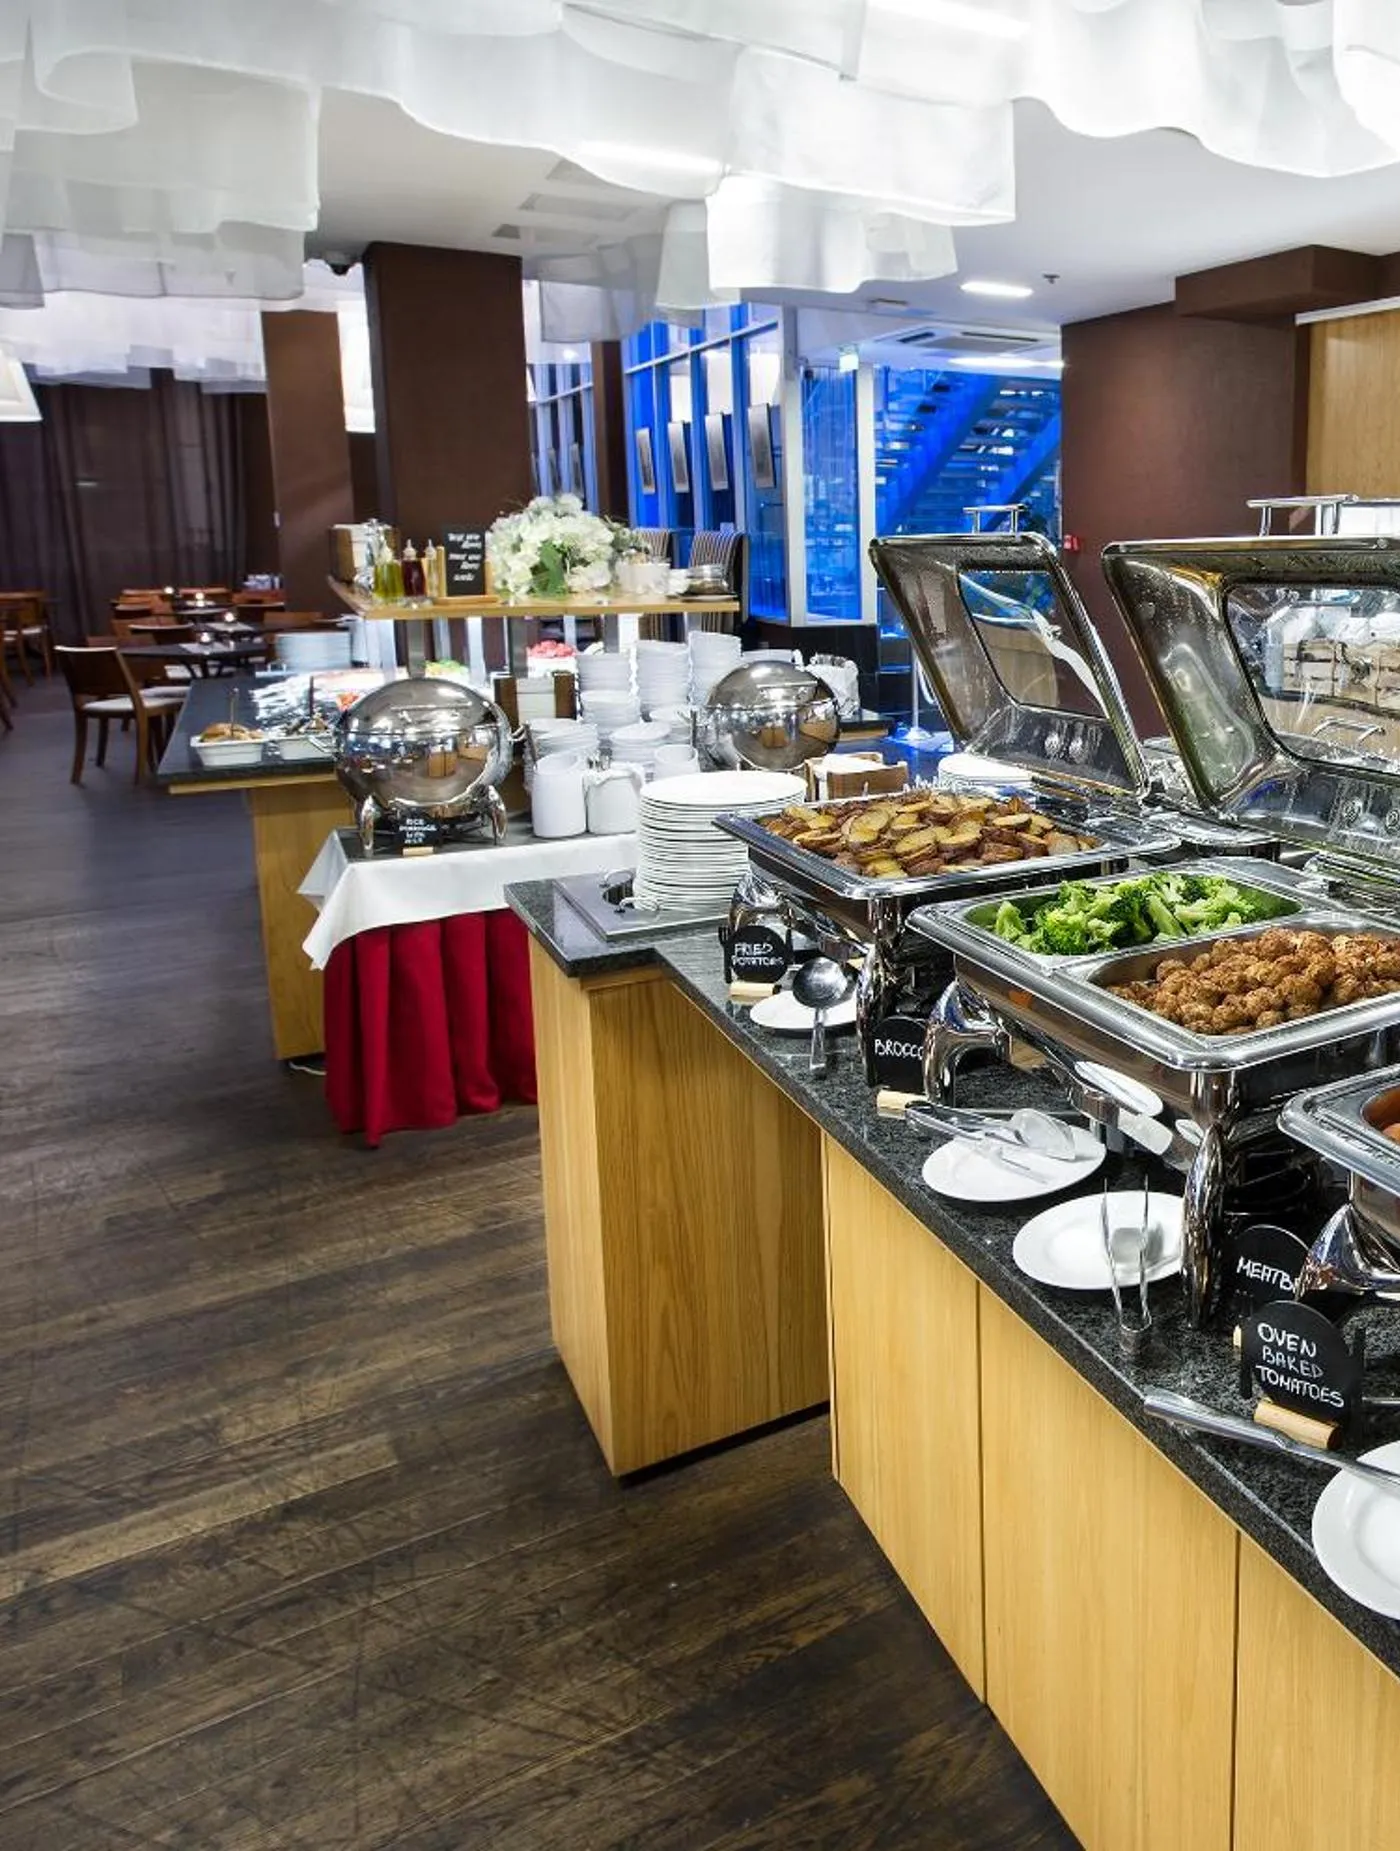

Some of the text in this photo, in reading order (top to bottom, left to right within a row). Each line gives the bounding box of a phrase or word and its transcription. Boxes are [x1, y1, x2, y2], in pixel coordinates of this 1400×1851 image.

[734, 942, 774, 956] FRIED
[1235, 1256, 1296, 1294] MEATB
[1257, 1322, 1317, 1358] OVEN
[1262, 1345, 1324, 1379] BAKED
[1255, 1363, 1345, 1408] TOMATOES
